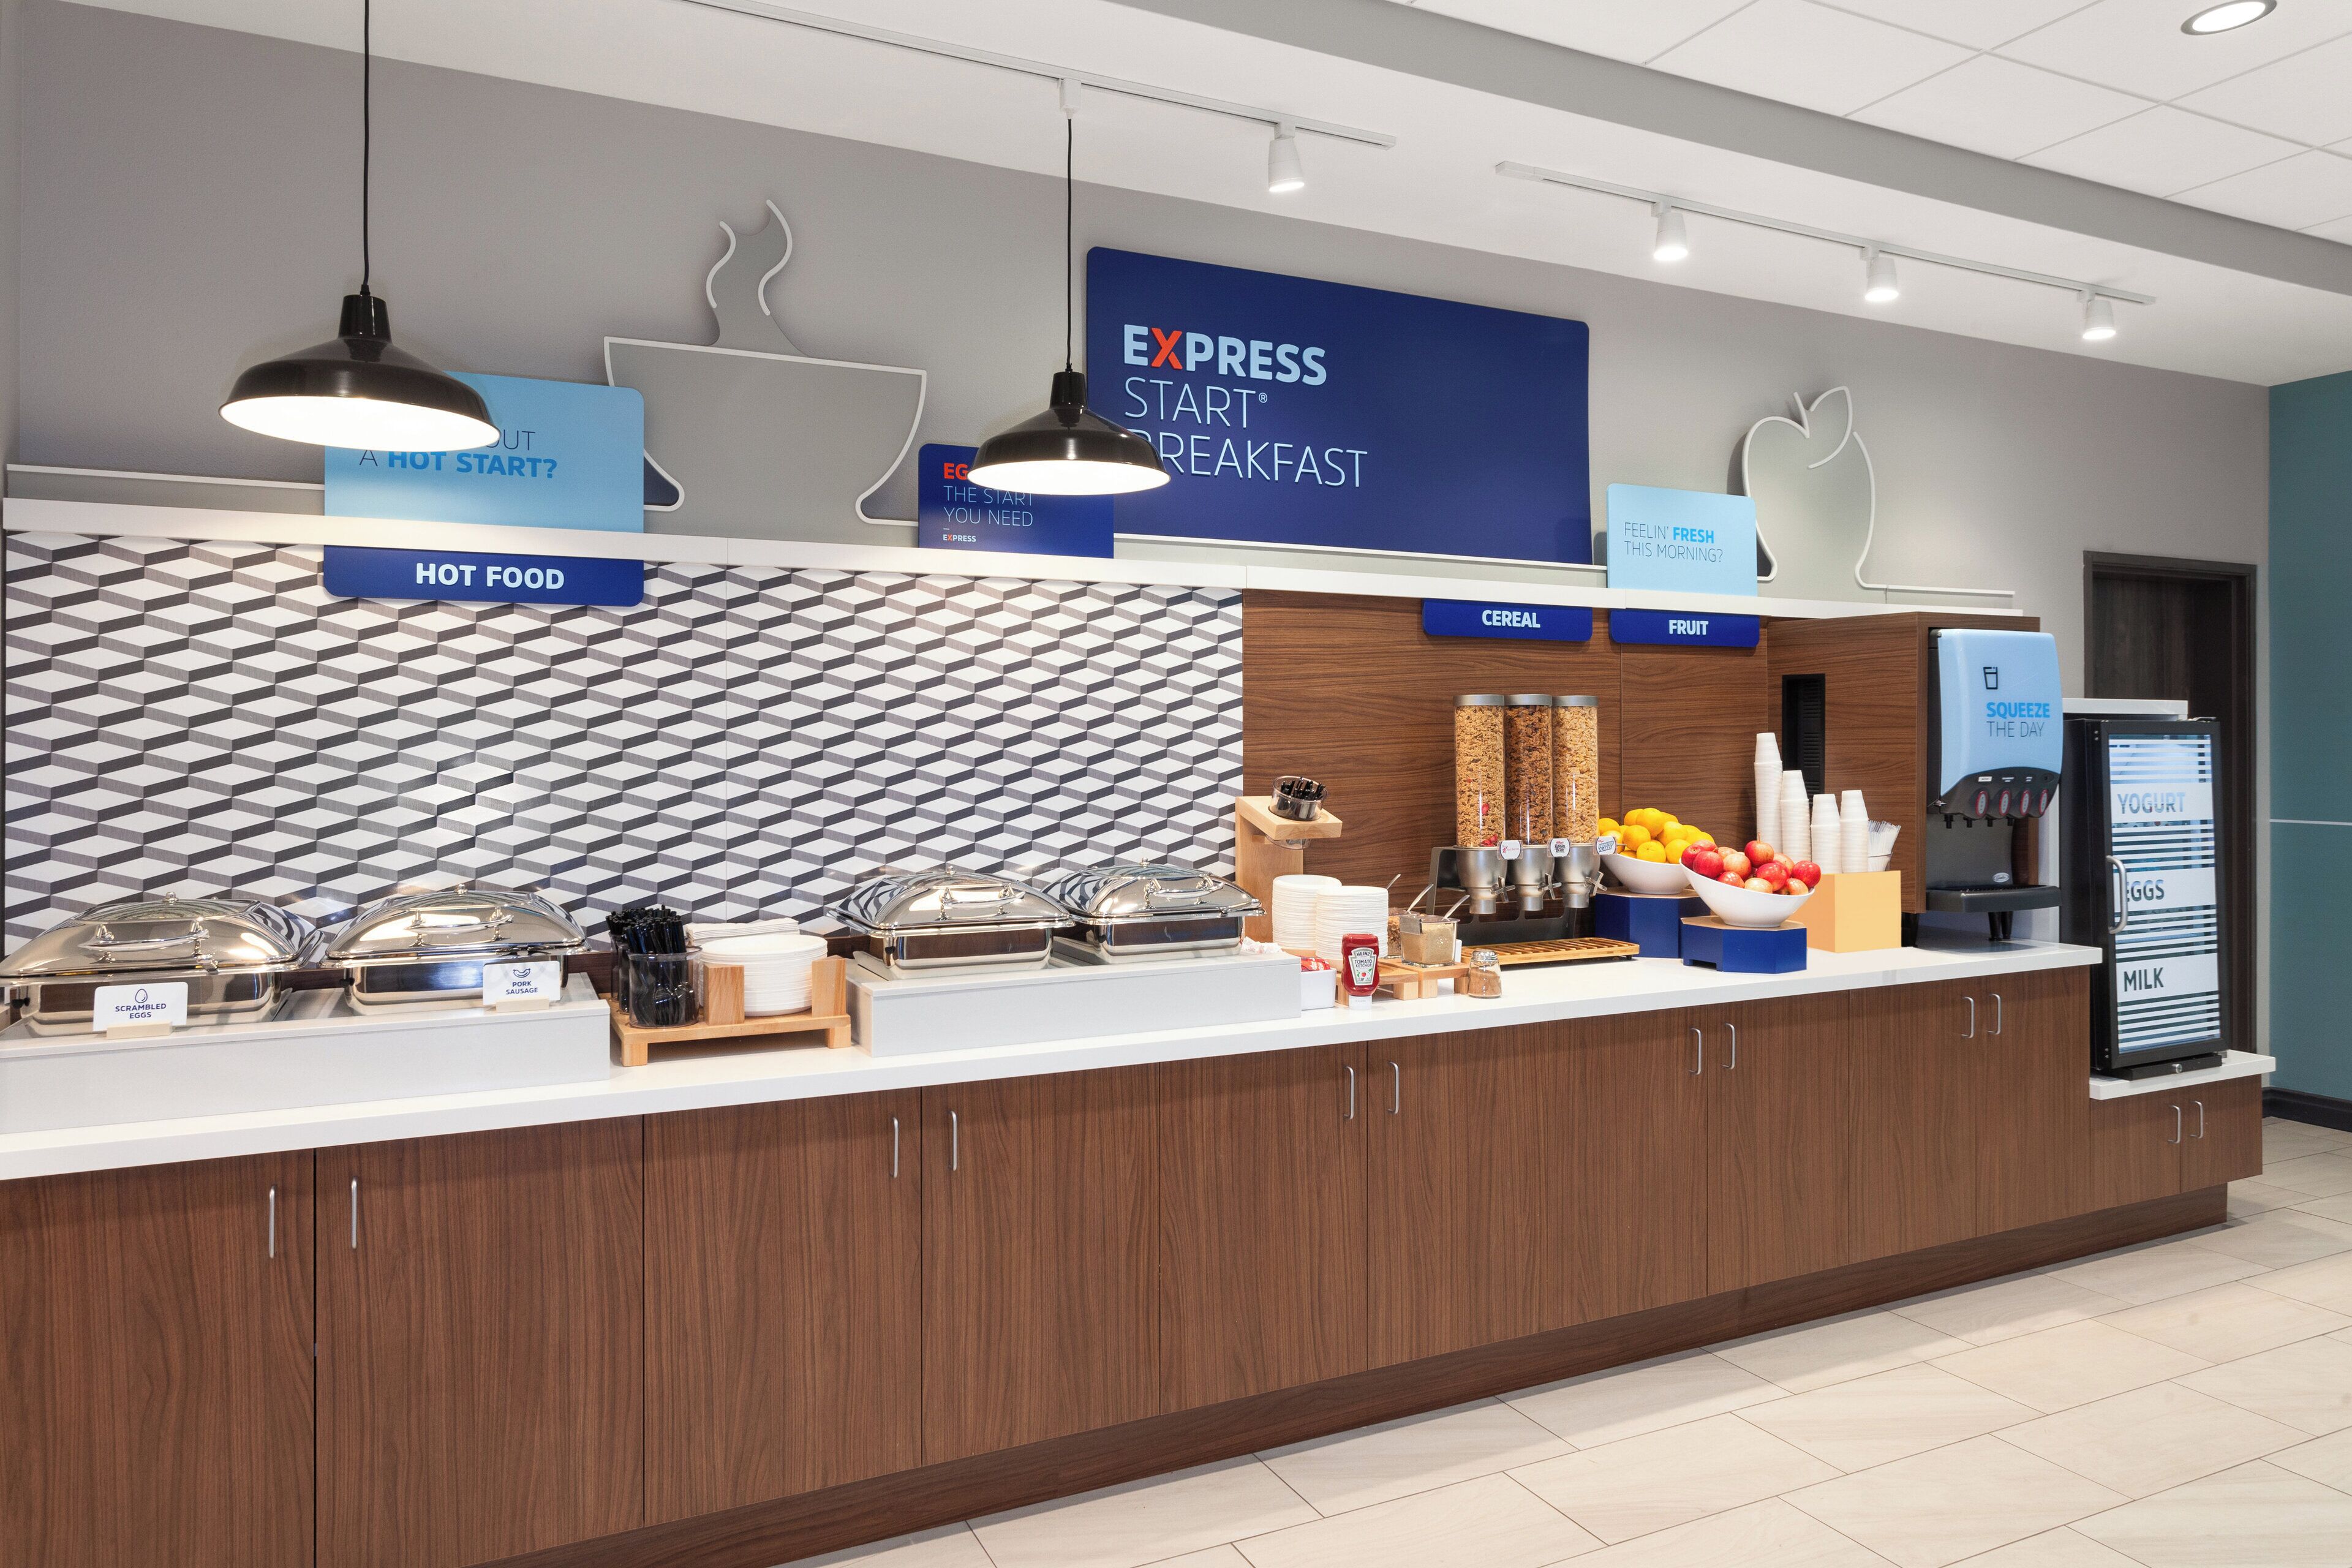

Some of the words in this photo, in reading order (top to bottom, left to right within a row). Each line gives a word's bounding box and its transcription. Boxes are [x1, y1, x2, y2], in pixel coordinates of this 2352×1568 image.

[1124, 324, 1327, 386] EXPRESS
[359, 450, 378, 467] A
[388, 451, 447, 470] HOT
[456, 453, 557, 478] START?
[1126, 429, 1368, 488] REAKFAST
[943, 463, 968, 480] EG
[943, 486, 977, 503] THE
[944, 507, 981, 524] YOU
[989, 510, 1033, 527] NEED
[1673, 527, 1714, 544] FRESH
[1624, 541, 1653, 557] THIS
[1657, 543, 1724, 562] MORNING?
[416, 562, 477, 587] HOT
[486, 566, 565, 590] FOOD
[1482, 609, 1541, 628] CEREAL
[1668, 619, 1709, 636] FRUIT
[1986, 701, 2051, 720] SQUEEZE
[1986, 721, 2015, 737] THE
[2020, 722, 2045, 737] DAY
[2117, 792, 2186, 814] YOGURT
[2124, 967, 2165, 992] MILK
[115, 1003, 167, 1012] SCRAMBLED
